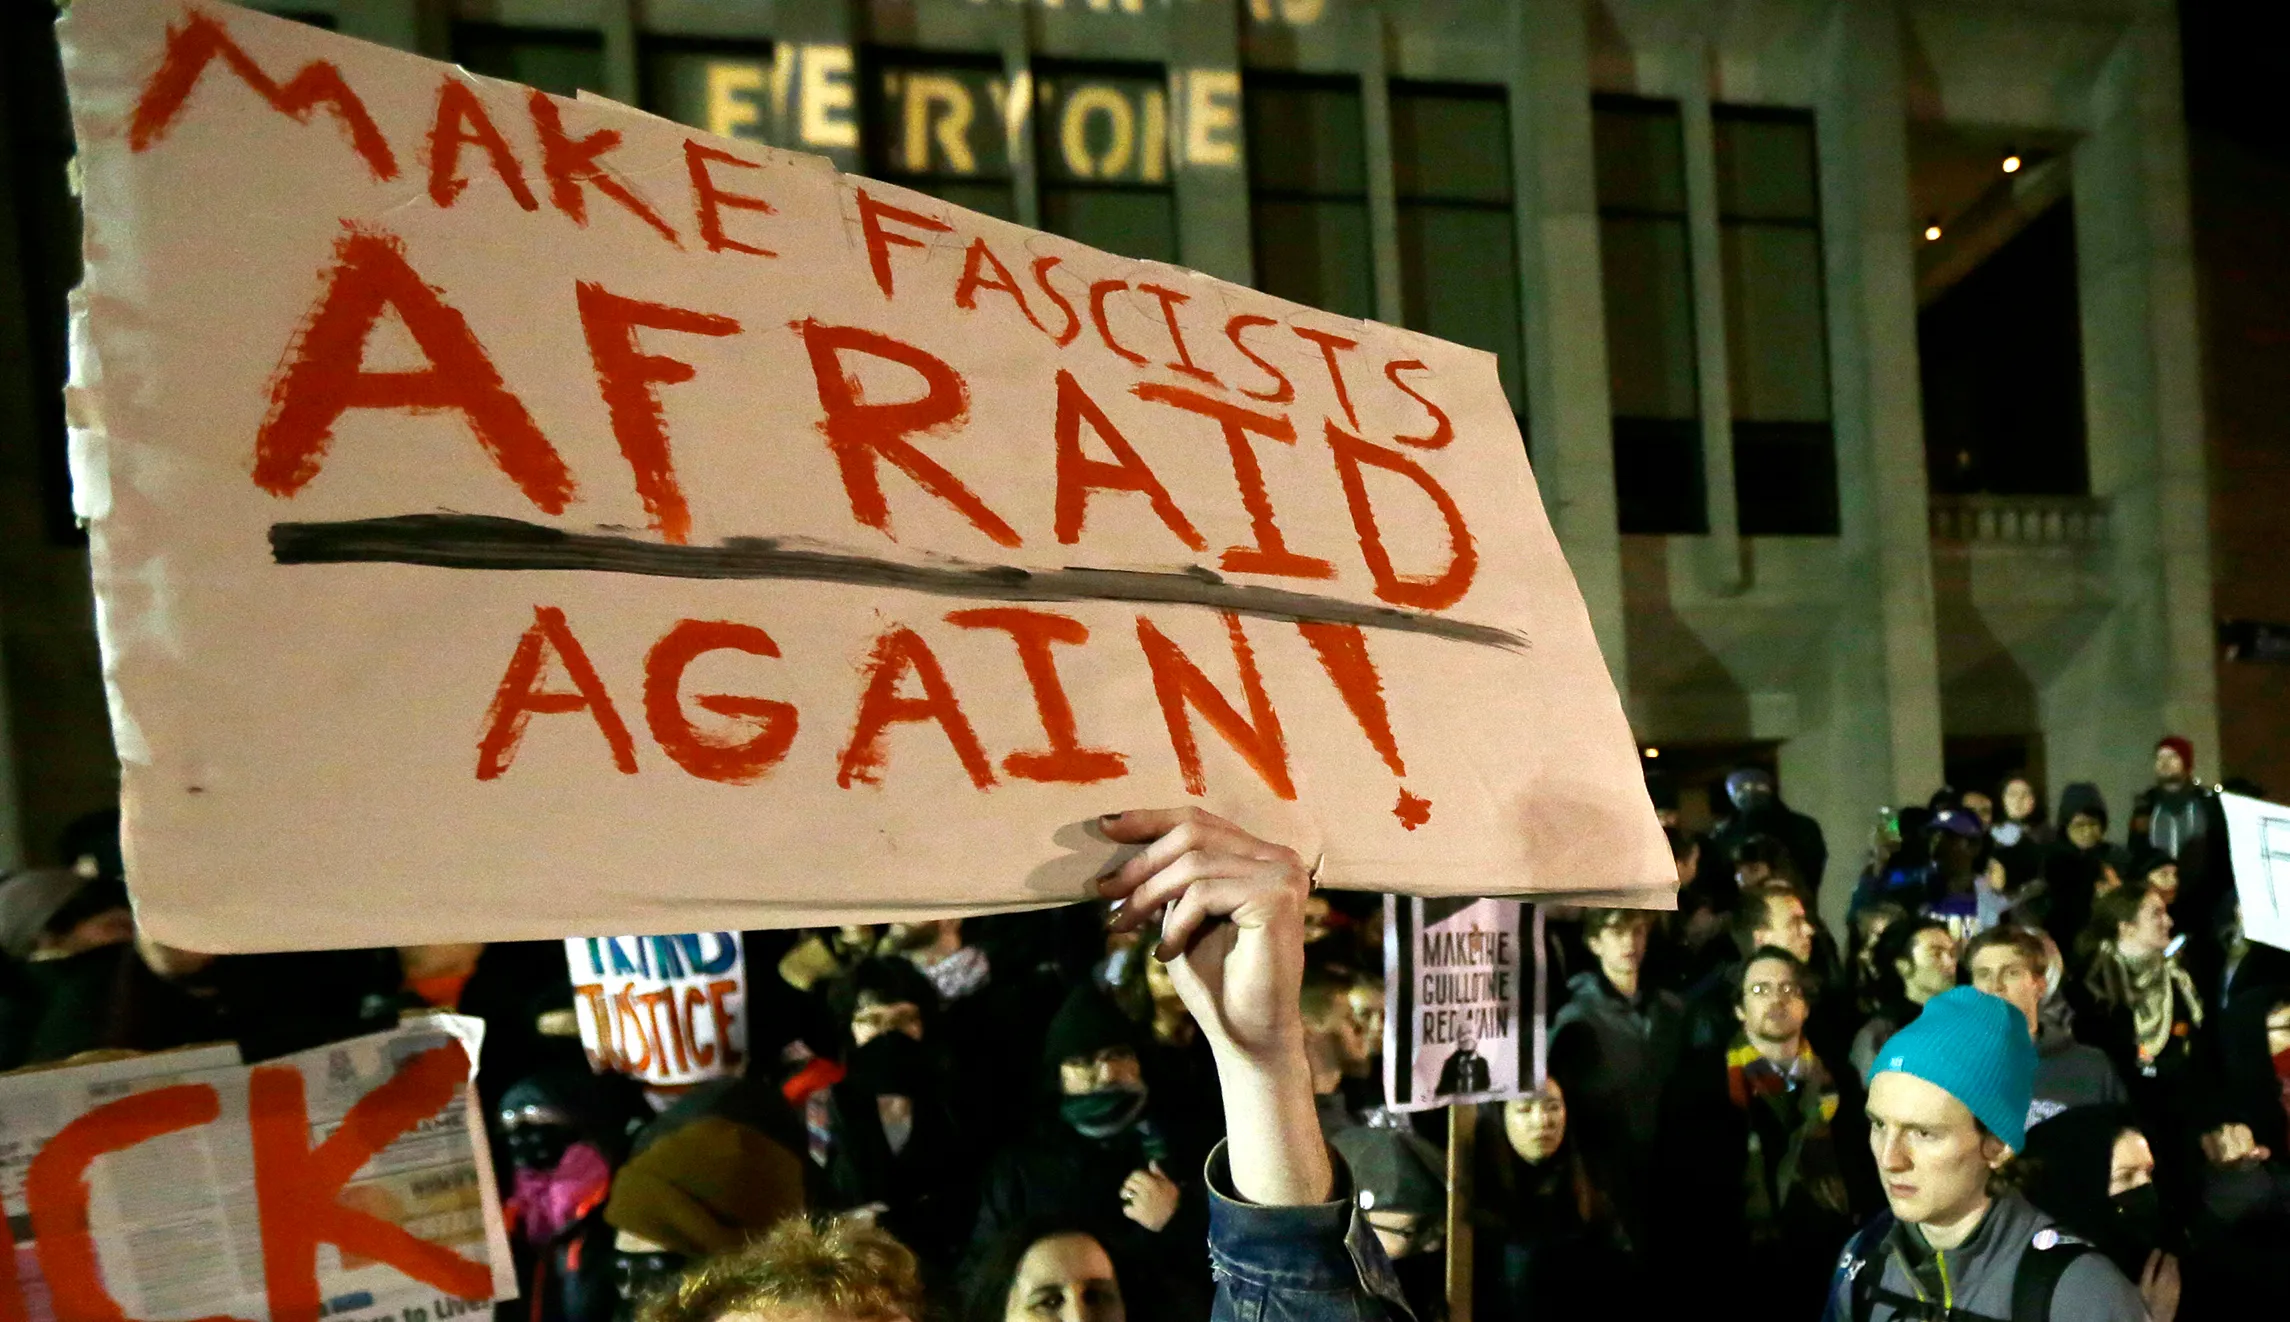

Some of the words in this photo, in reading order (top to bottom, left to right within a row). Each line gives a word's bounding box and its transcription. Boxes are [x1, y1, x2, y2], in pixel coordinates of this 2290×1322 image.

[128, 8, 778, 257] MAKE
[855, 187, 1455, 451] FASCISTS
[251, 219, 1478, 611] AFRAID
[474, 604, 1433, 831] AGAIN!
[574, 979, 742, 1076] JUSTICE
[0, 1035, 494, 1322] CK
